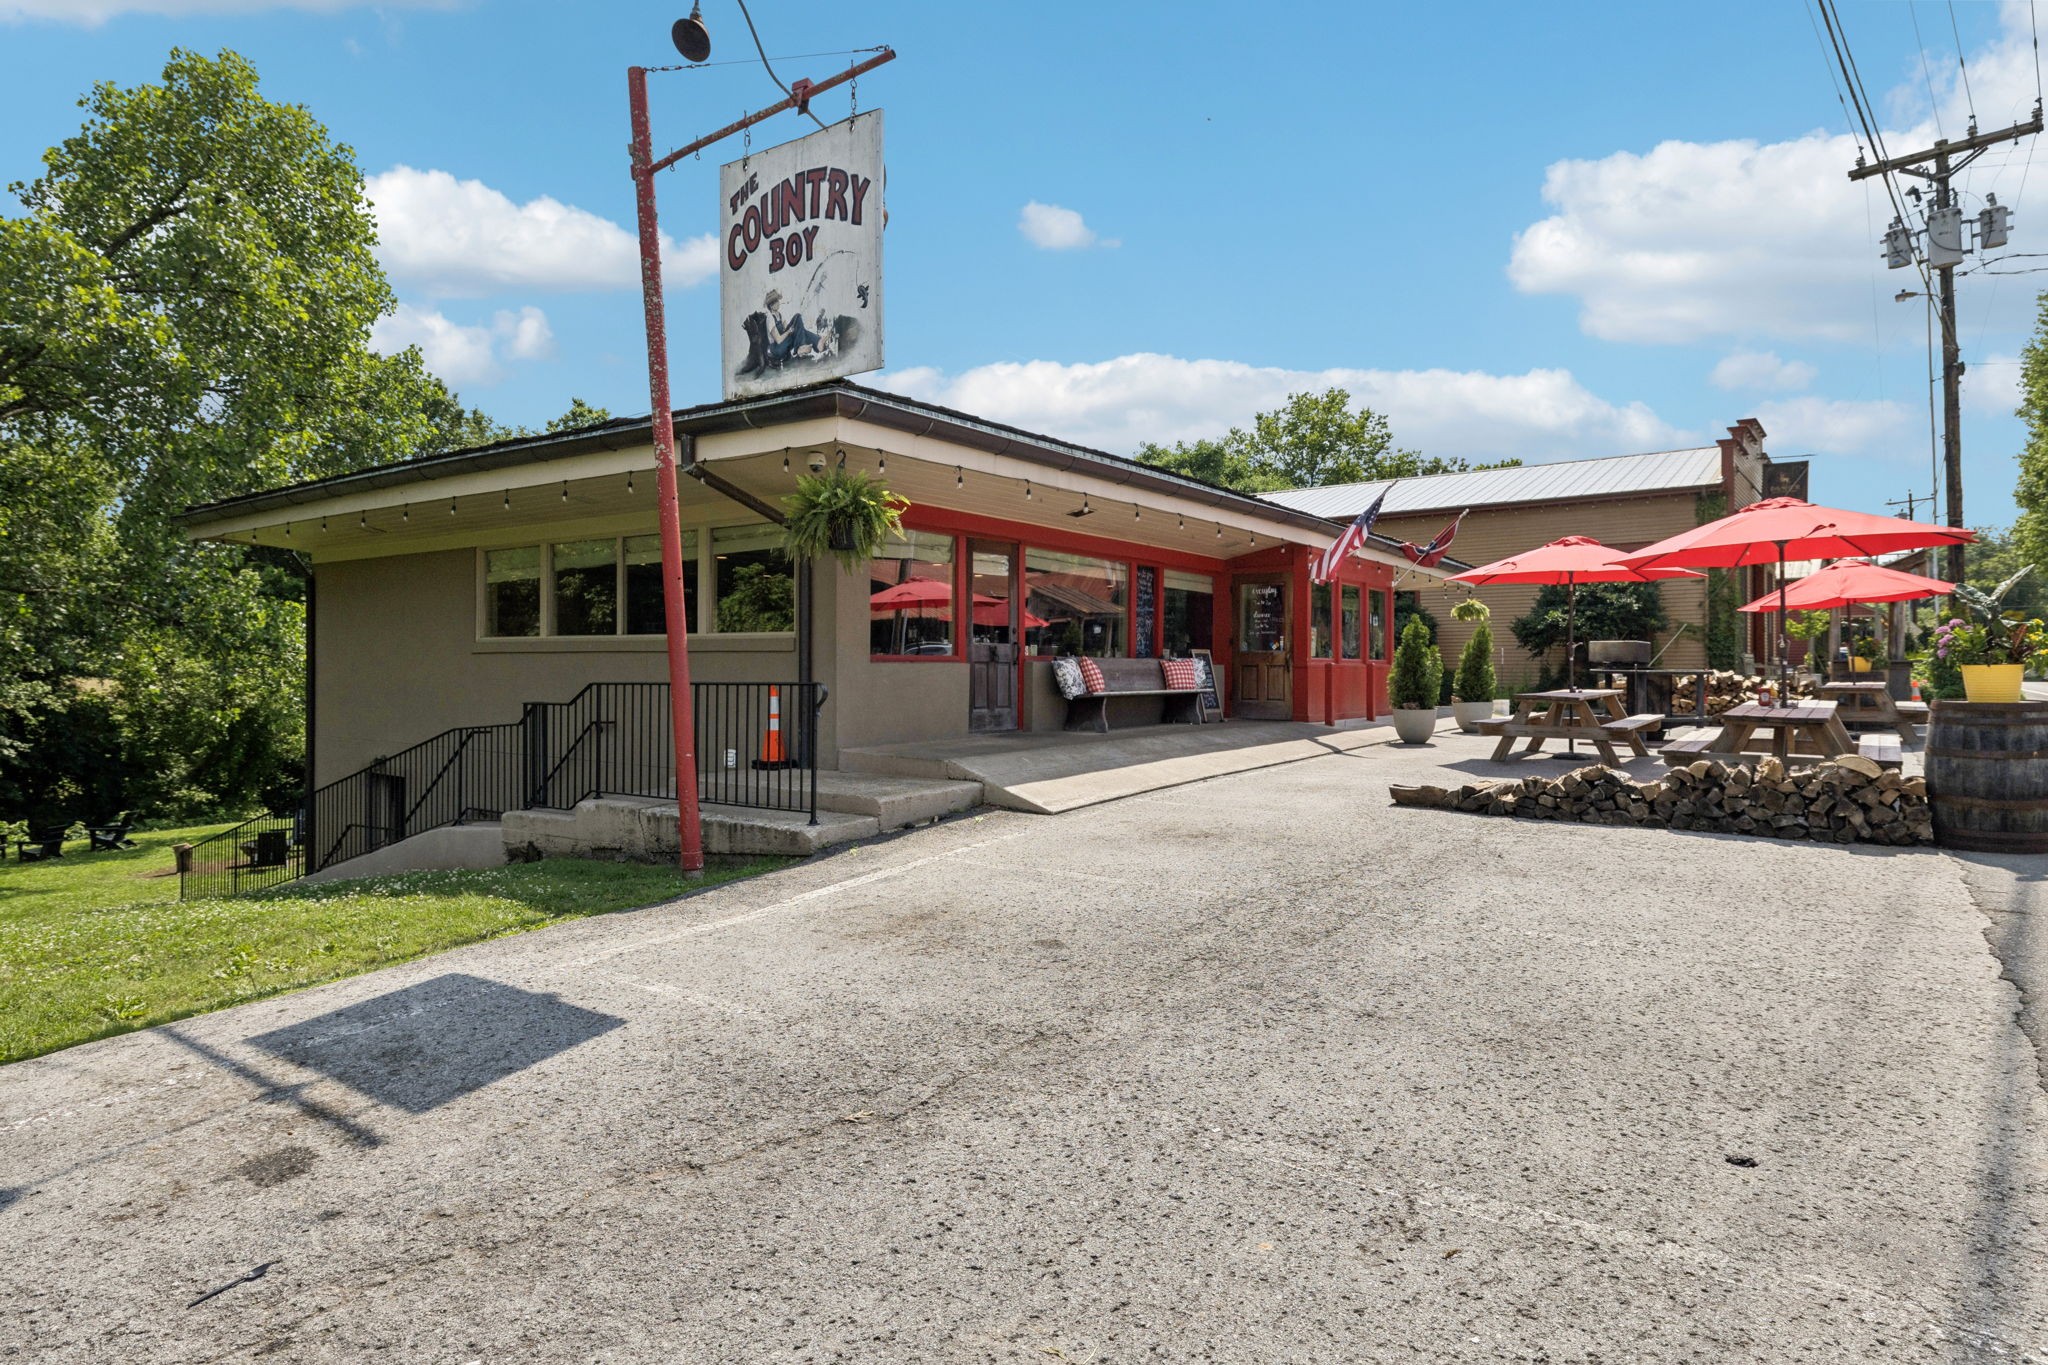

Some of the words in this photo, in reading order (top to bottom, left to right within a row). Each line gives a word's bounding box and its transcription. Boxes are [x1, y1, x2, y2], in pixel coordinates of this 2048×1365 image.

[729, 171, 759, 215] THE
[728, 165, 871, 272] COUNTRY
[769, 225, 820, 274] BOY
